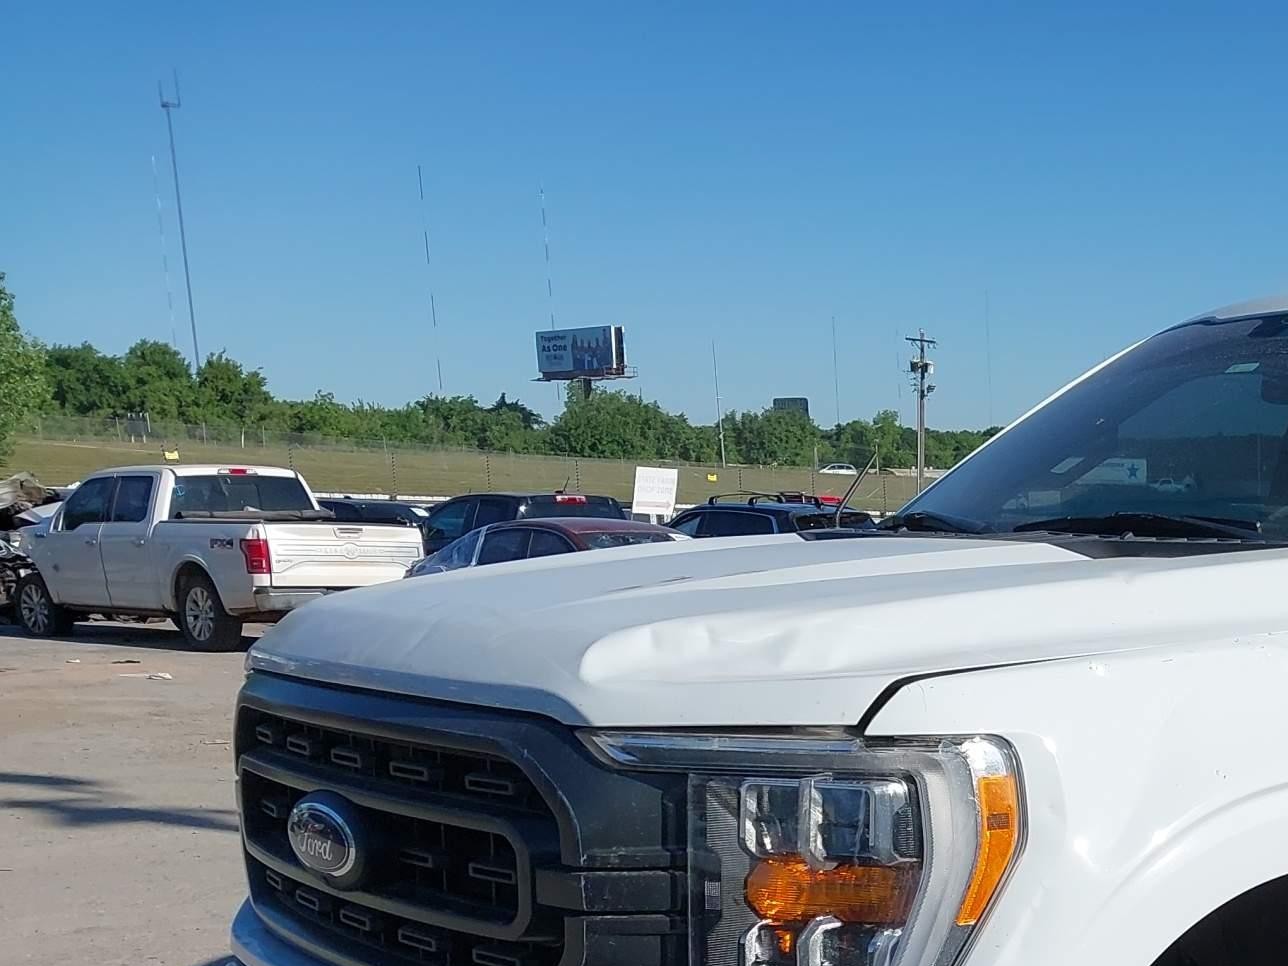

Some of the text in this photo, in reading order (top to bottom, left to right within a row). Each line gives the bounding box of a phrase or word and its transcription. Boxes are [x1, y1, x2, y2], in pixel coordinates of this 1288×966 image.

[542, 344, 568, 352] As One
[210, 538, 234, 550] FX4
[298, 829, 333, 861] Ford
